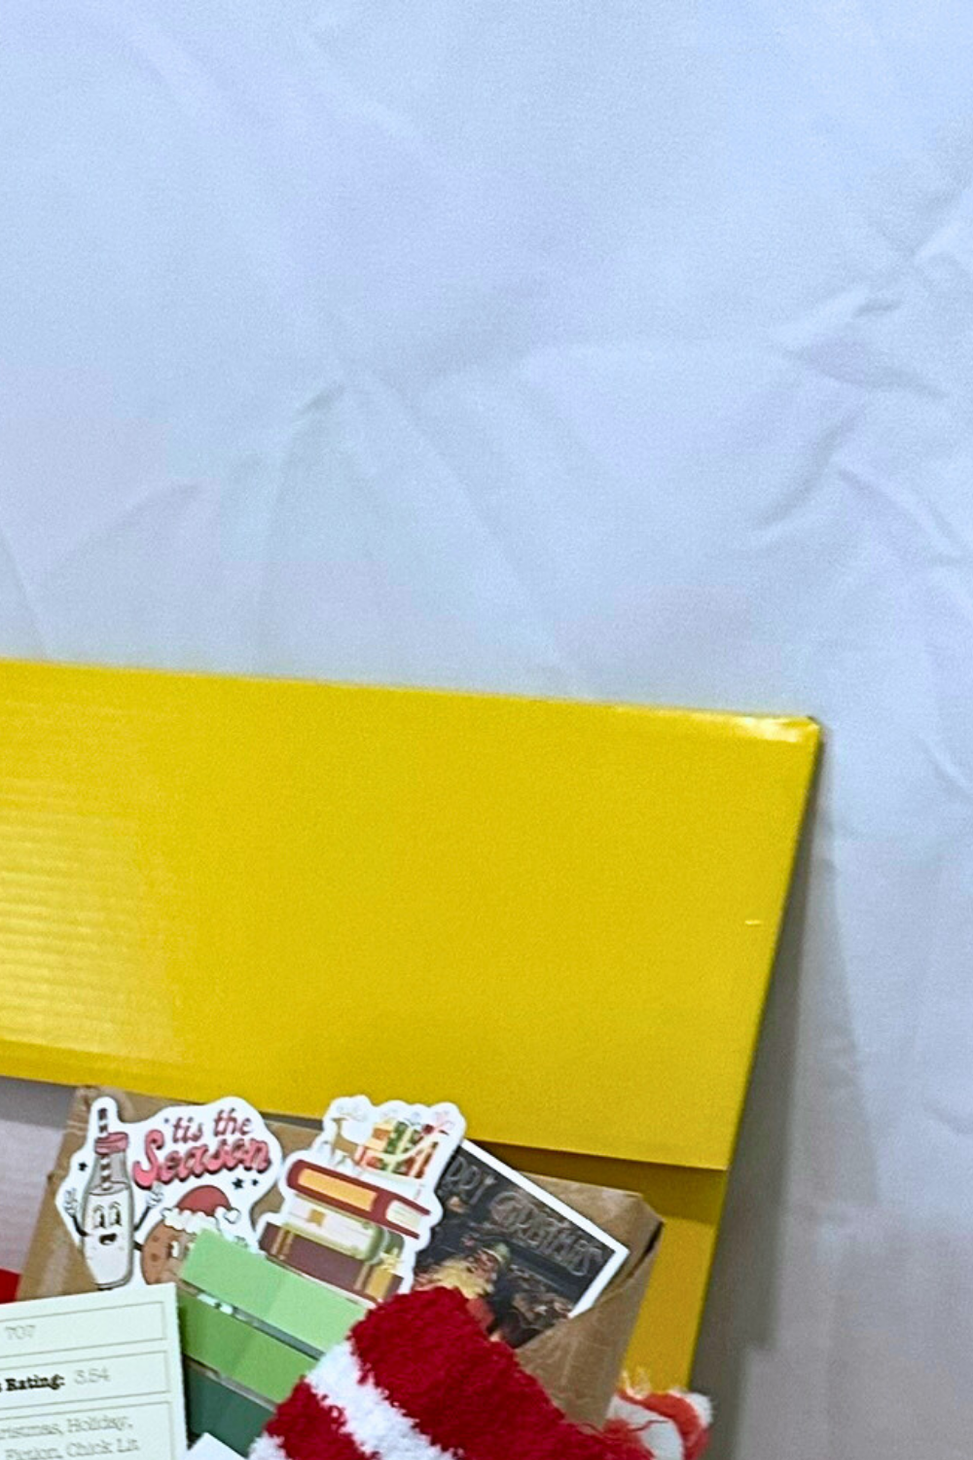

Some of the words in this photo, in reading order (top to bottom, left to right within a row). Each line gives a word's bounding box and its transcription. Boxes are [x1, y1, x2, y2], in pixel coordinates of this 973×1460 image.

[213, 1107, 253, 1137] the
[132, 1128, 272, 1190] Season
[4, 1373, 66, 1393] Rating:
[66, 1413, 134, 1434] Holiday,
[65, 1439, 114, 1459] Chick
